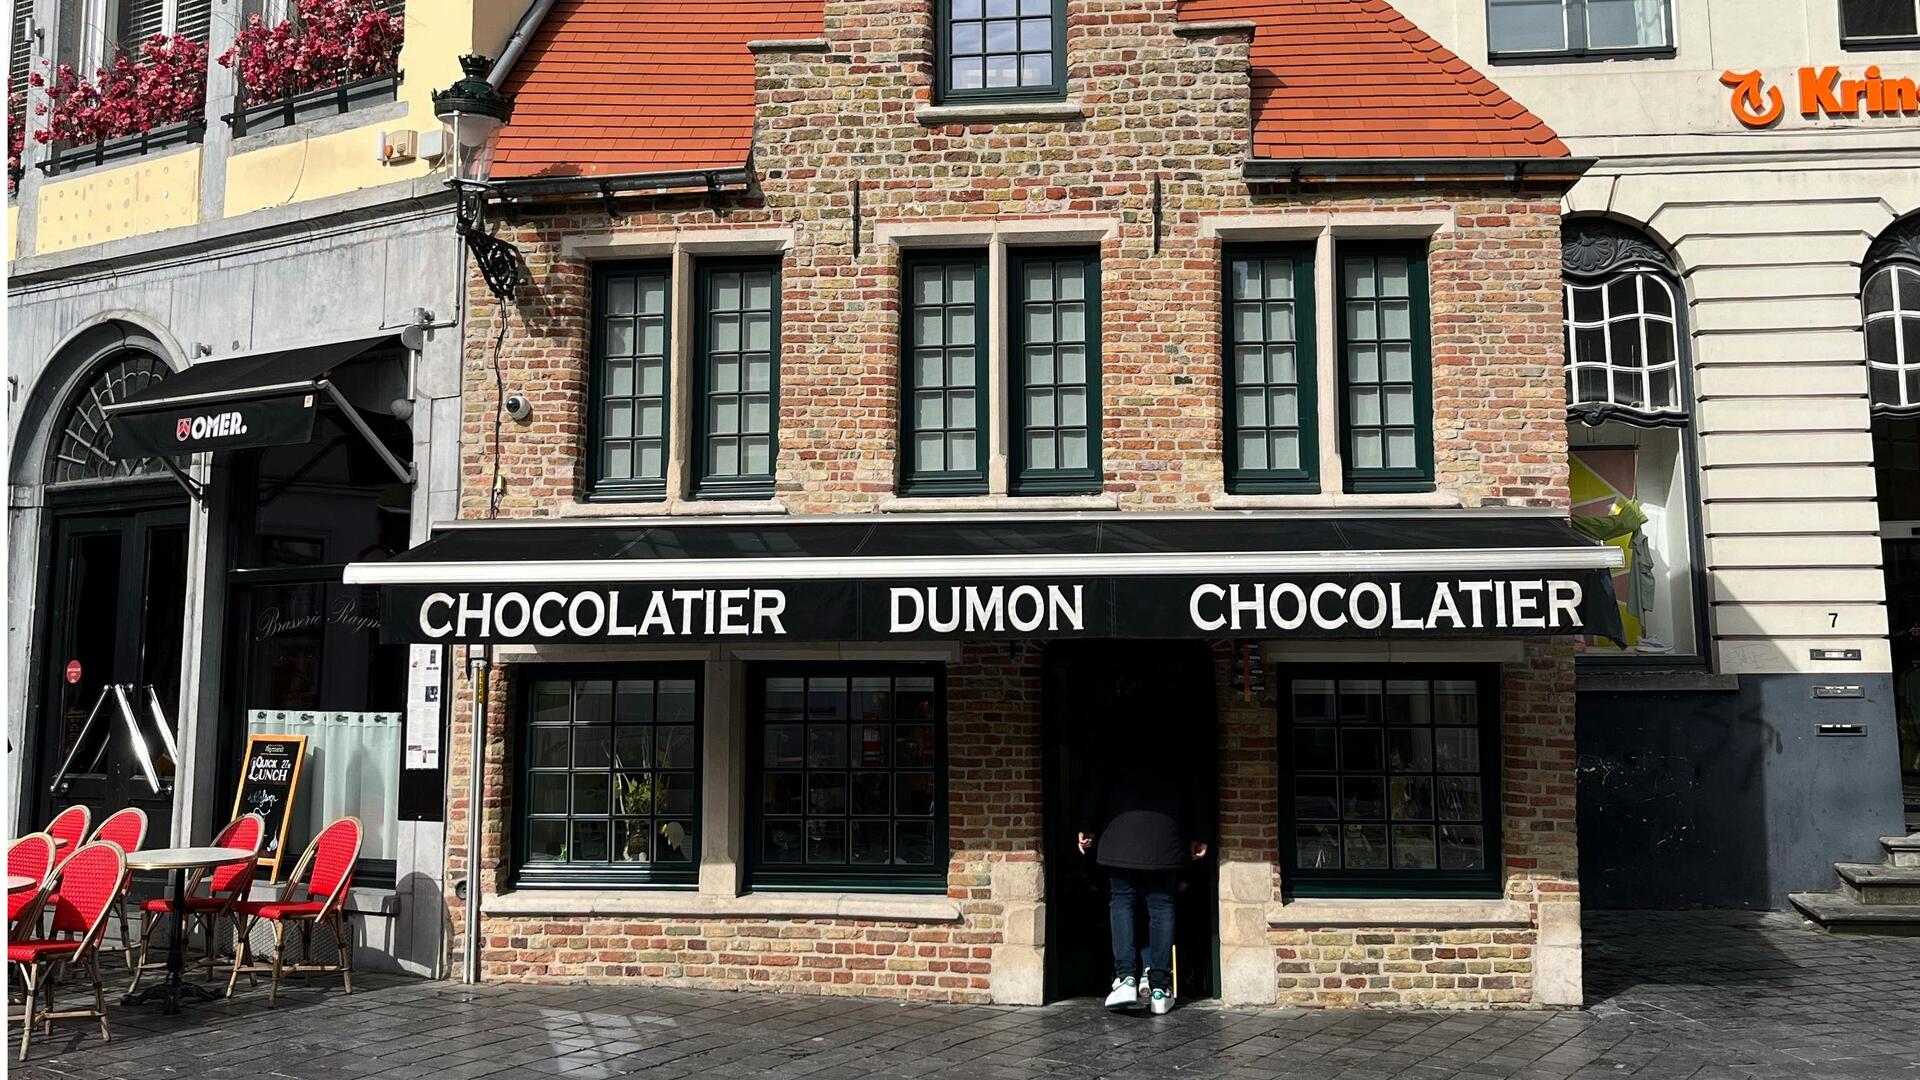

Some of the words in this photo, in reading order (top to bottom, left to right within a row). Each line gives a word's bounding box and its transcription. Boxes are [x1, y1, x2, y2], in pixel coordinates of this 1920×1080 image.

[1798, 64, 1920, 114] Krin
[255, 606, 322, 641] Brasserie
[419, 587, 787, 638] CHOCOLATIER
[889, 584, 1084, 633] DUMON
[1189, 579, 1583, 632] CHOCOLATIER
[1828, 612, 1838, 628] 7
